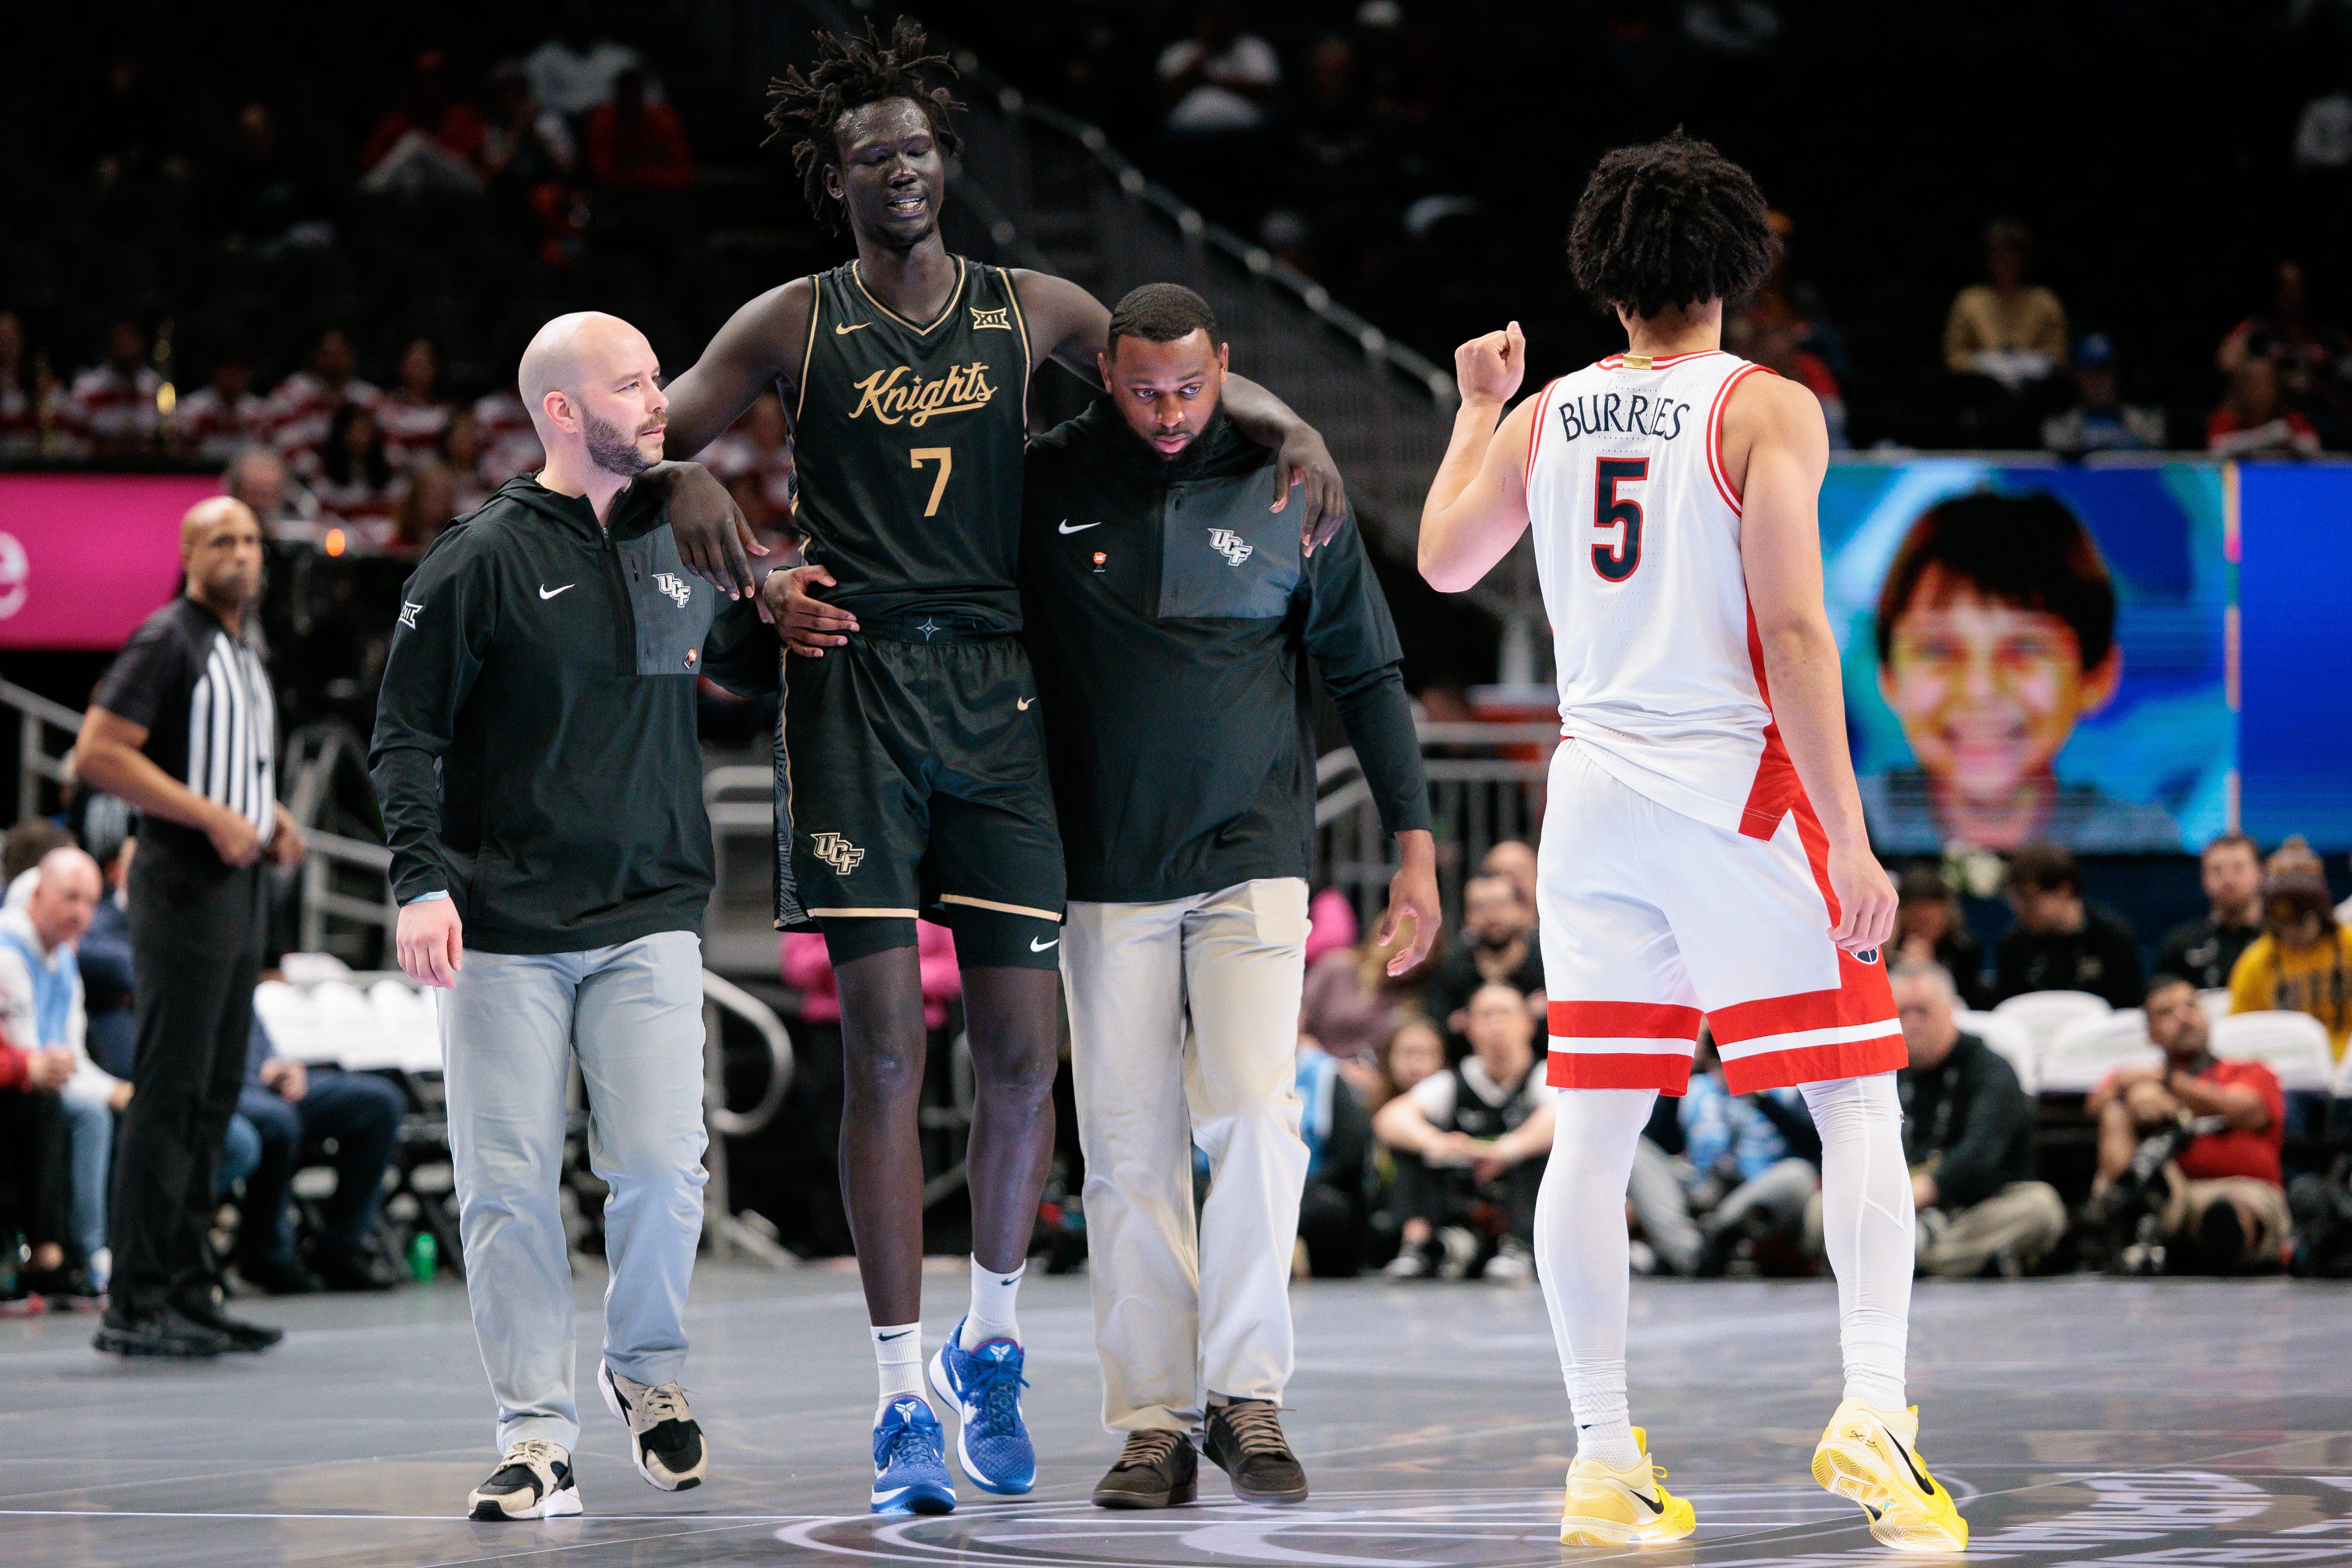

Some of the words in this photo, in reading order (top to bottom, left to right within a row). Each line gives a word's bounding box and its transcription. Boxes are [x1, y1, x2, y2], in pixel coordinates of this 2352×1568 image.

[849, 362, 997, 426] Knights
[1558, 393, 1690, 442] BURRIES
[910, 447, 952, 517] 7
[1591, 456, 1650, 582] 5
[1207, 528, 1253, 567] UCF
[651, 573, 691, 608] UCF
[810, 832, 864, 875] UCF
